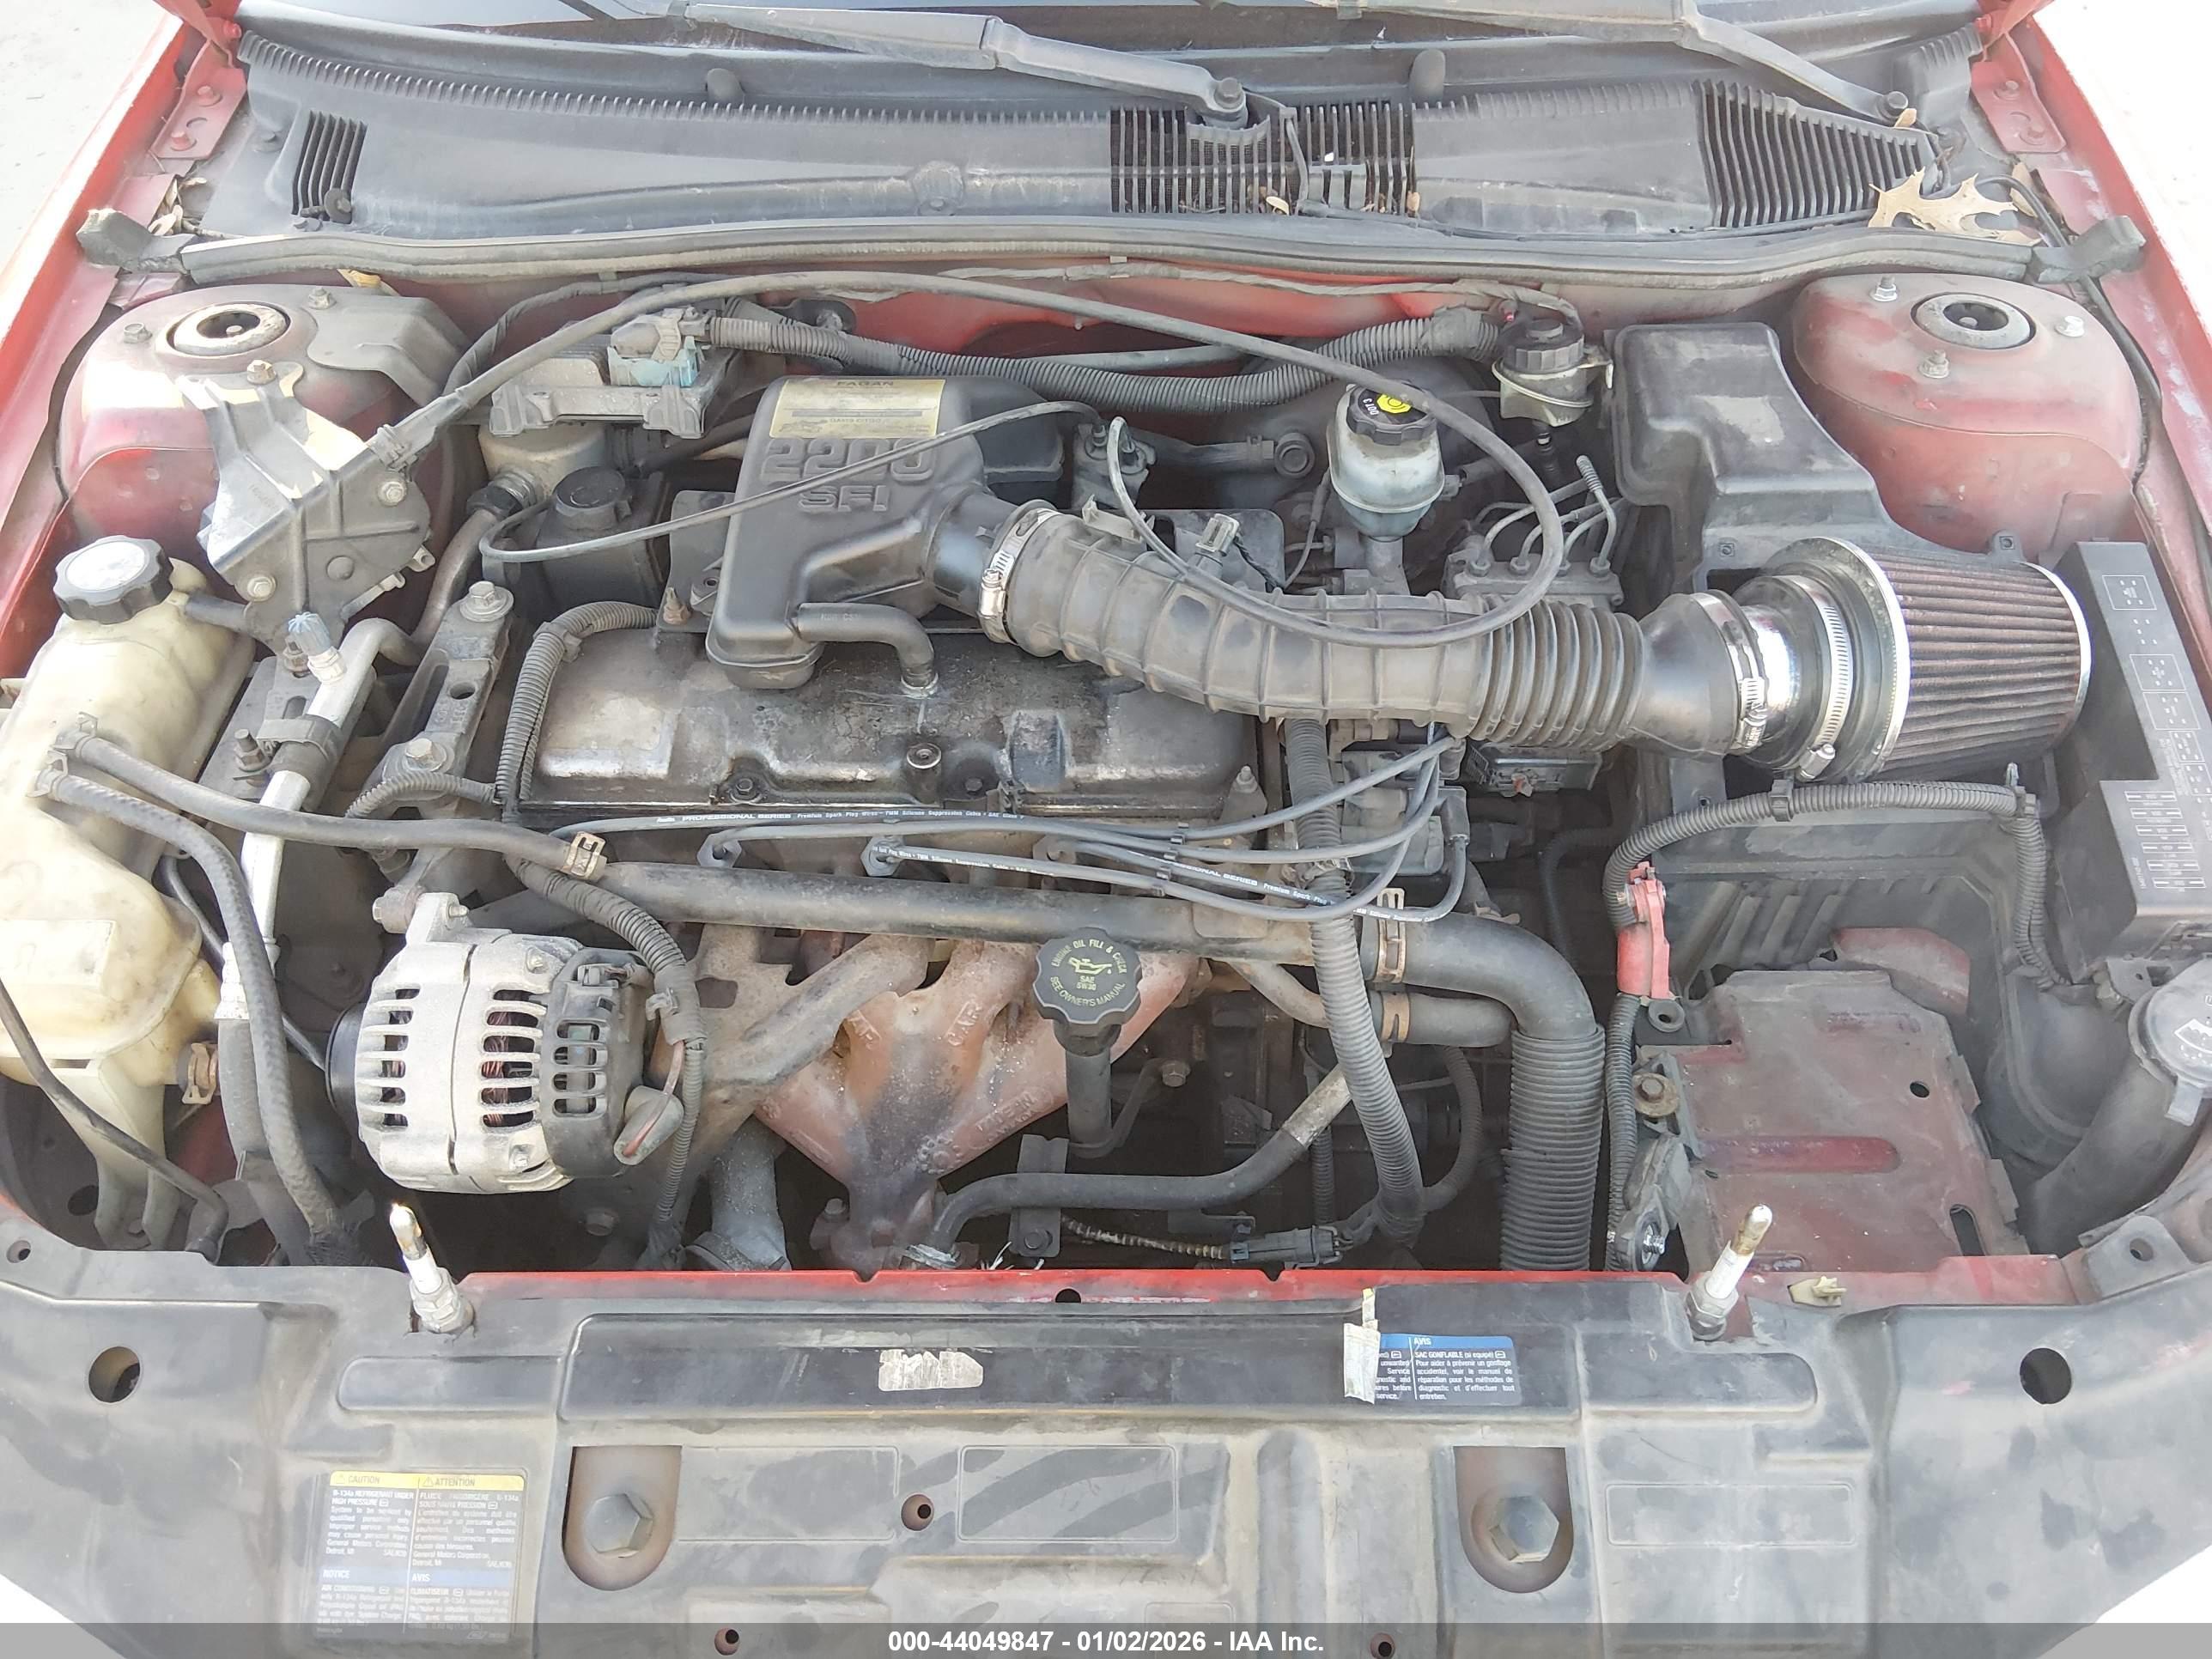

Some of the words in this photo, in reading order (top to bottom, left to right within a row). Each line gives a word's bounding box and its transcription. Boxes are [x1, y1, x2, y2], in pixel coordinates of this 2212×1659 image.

[1364, 404, 1380, 416] DOT
[797, 484, 891, 513] SFI
[682, 813, 756, 822] PROFESSIONAL
[1223, 872, 1258, 886] SERIES
[1263, 882, 1291, 896] Premium
[1292, 890, 1312, 901] Spark
[1051, 945, 1073, 967] ENGINE
[1073, 939, 1086, 949] OIL
[1089, 939, 1104, 949] FILL
[1112, 952, 1127, 974] CHECK
[1050, 976, 1064, 992] SEE
[1096, 982, 1127, 1006] MANUAL
[1413, 1337, 1432, 1346] AVIS
[348, 1474, 380, 1485] CAUTION
[434, 1478, 476, 1487] ATTENTION
[322, 1569, 350, 1579] NOTICE
[411, 1572, 431, 1583] AVIS
